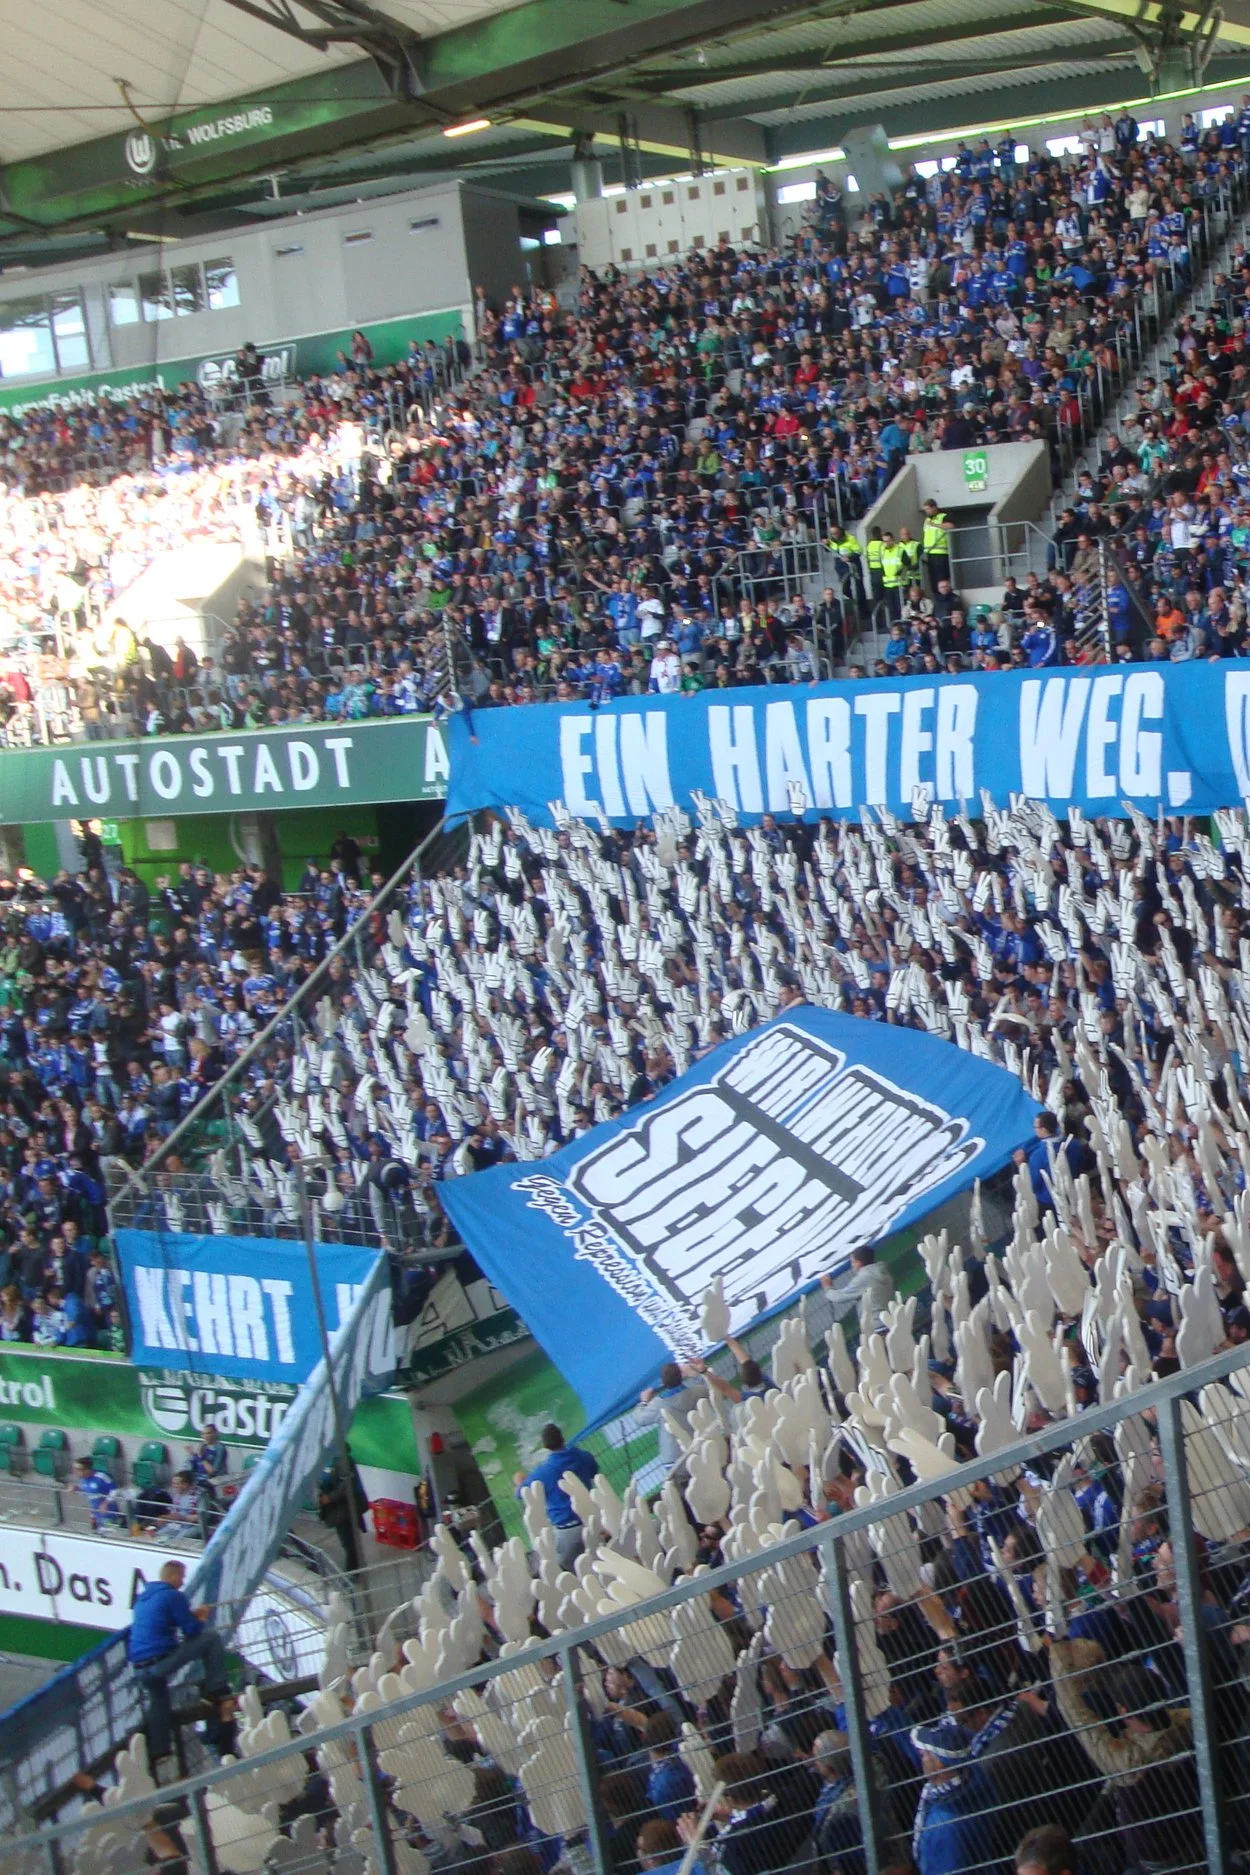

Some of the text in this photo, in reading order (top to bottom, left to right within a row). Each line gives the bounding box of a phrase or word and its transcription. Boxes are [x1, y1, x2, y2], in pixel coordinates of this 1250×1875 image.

[186, 106, 274, 146] WOLFSBURG
[964, 458, 987, 475] 30
[51, 736, 355, 806] AUTOSTADT
[560, 711, 675, 818] EIN
[708, 684, 979, 813] HARTER
[1019, 670, 1192, 808] WEG.
[718, 1028, 842, 1122] WIR
[133, 1264, 296, 1364] KEHRT
[33, 1551, 114, 1607] Das
